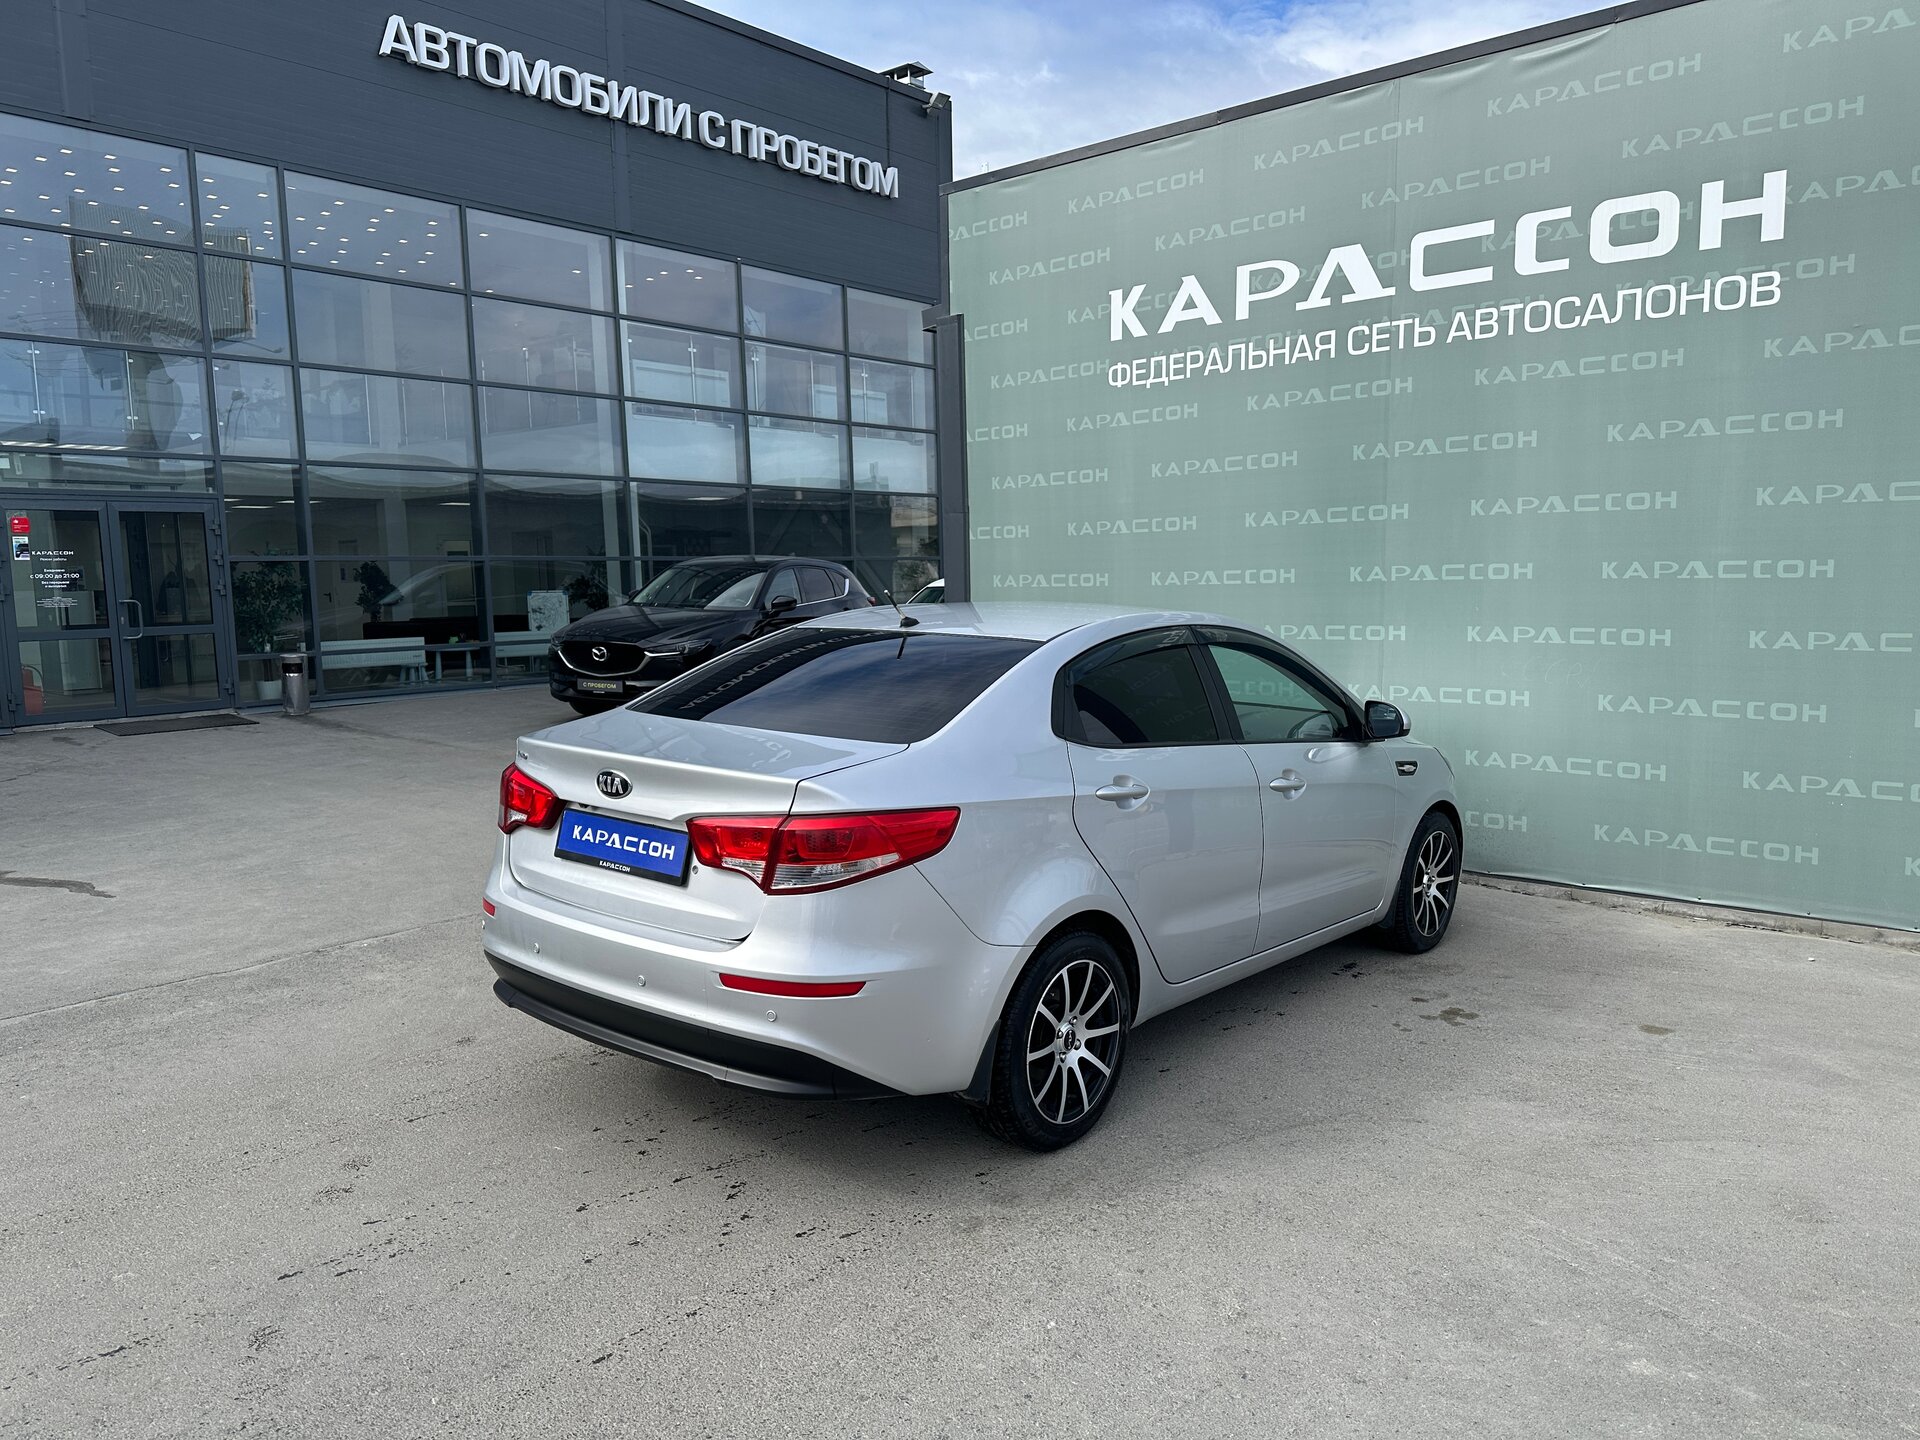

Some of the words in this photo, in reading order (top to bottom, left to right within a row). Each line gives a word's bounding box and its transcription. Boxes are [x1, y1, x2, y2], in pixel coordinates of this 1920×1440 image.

[1486, 53, 1701, 118] КАРАССОН
[379, 14, 692, 141] АВТОМОБИЛИ
[699, 110, 726, 150] С
[731, 118, 899, 199] ПРОБЕГОМ
[1253, 115, 1424, 171] КАРАССОН
[1621, 95, 1864, 159] КАРАССОН
[1068, 168, 1203, 214] КАРАССОН
[1361, 155, 1551, 209] КАРАССОН
[1155, 206, 1305, 251] КАРАССОН
[989, 247, 1110, 286] КАРАССОН
[1109, 169, 1788, 342] КАРАССОН
[1107, 330, 1336, 389] ФЕДЕРАЛЬНАЯ
[1347, 316, 1437, 356] СЕТЬ
[1446, 270, 1782, 344] АВТОСАЛОНОВ
[1475, 348, 1684, 387] КАРАССОН
[1247, 376, 1413, 411] КАРАССОН
[1067, 403, 1198, 432] КАРАССОН
[1607, 408, 1843, 443] КАРАССОН
[1353, 431, 1538, 461] КАРАССОН
[992, 468, 1108, 490] КАРАССОН
[1152, 450, 1297, 478] КАРАССОН
[1245, 503, 1409, 528] КАРАССОН
[1471, 491, 1677, 516] КАРАССОН
[1068, 516, 1196, 537] КАРАССОН
[993, 573, 1109, 588] КАРАССОН
[1151, 568, 1295, 587] КАРАССОН
[1350, 562, 1534, 582] КАРАССОН
[1602, 559, 1834, 580] КАРАССОН
[1467, 626, 1671, 647] КАРАССОН
[1598, 694, 1827, 724] КАРАССОН
[1465, 749, 1666, 783] КАРАССОН
[598, 774, 624, 795] KIA
[572, 824, 676, 860] КАРАССОН
[1594, 824, 1819, 866] КАРАССОН
[599, 860, 631, 873] КАРАССОН
